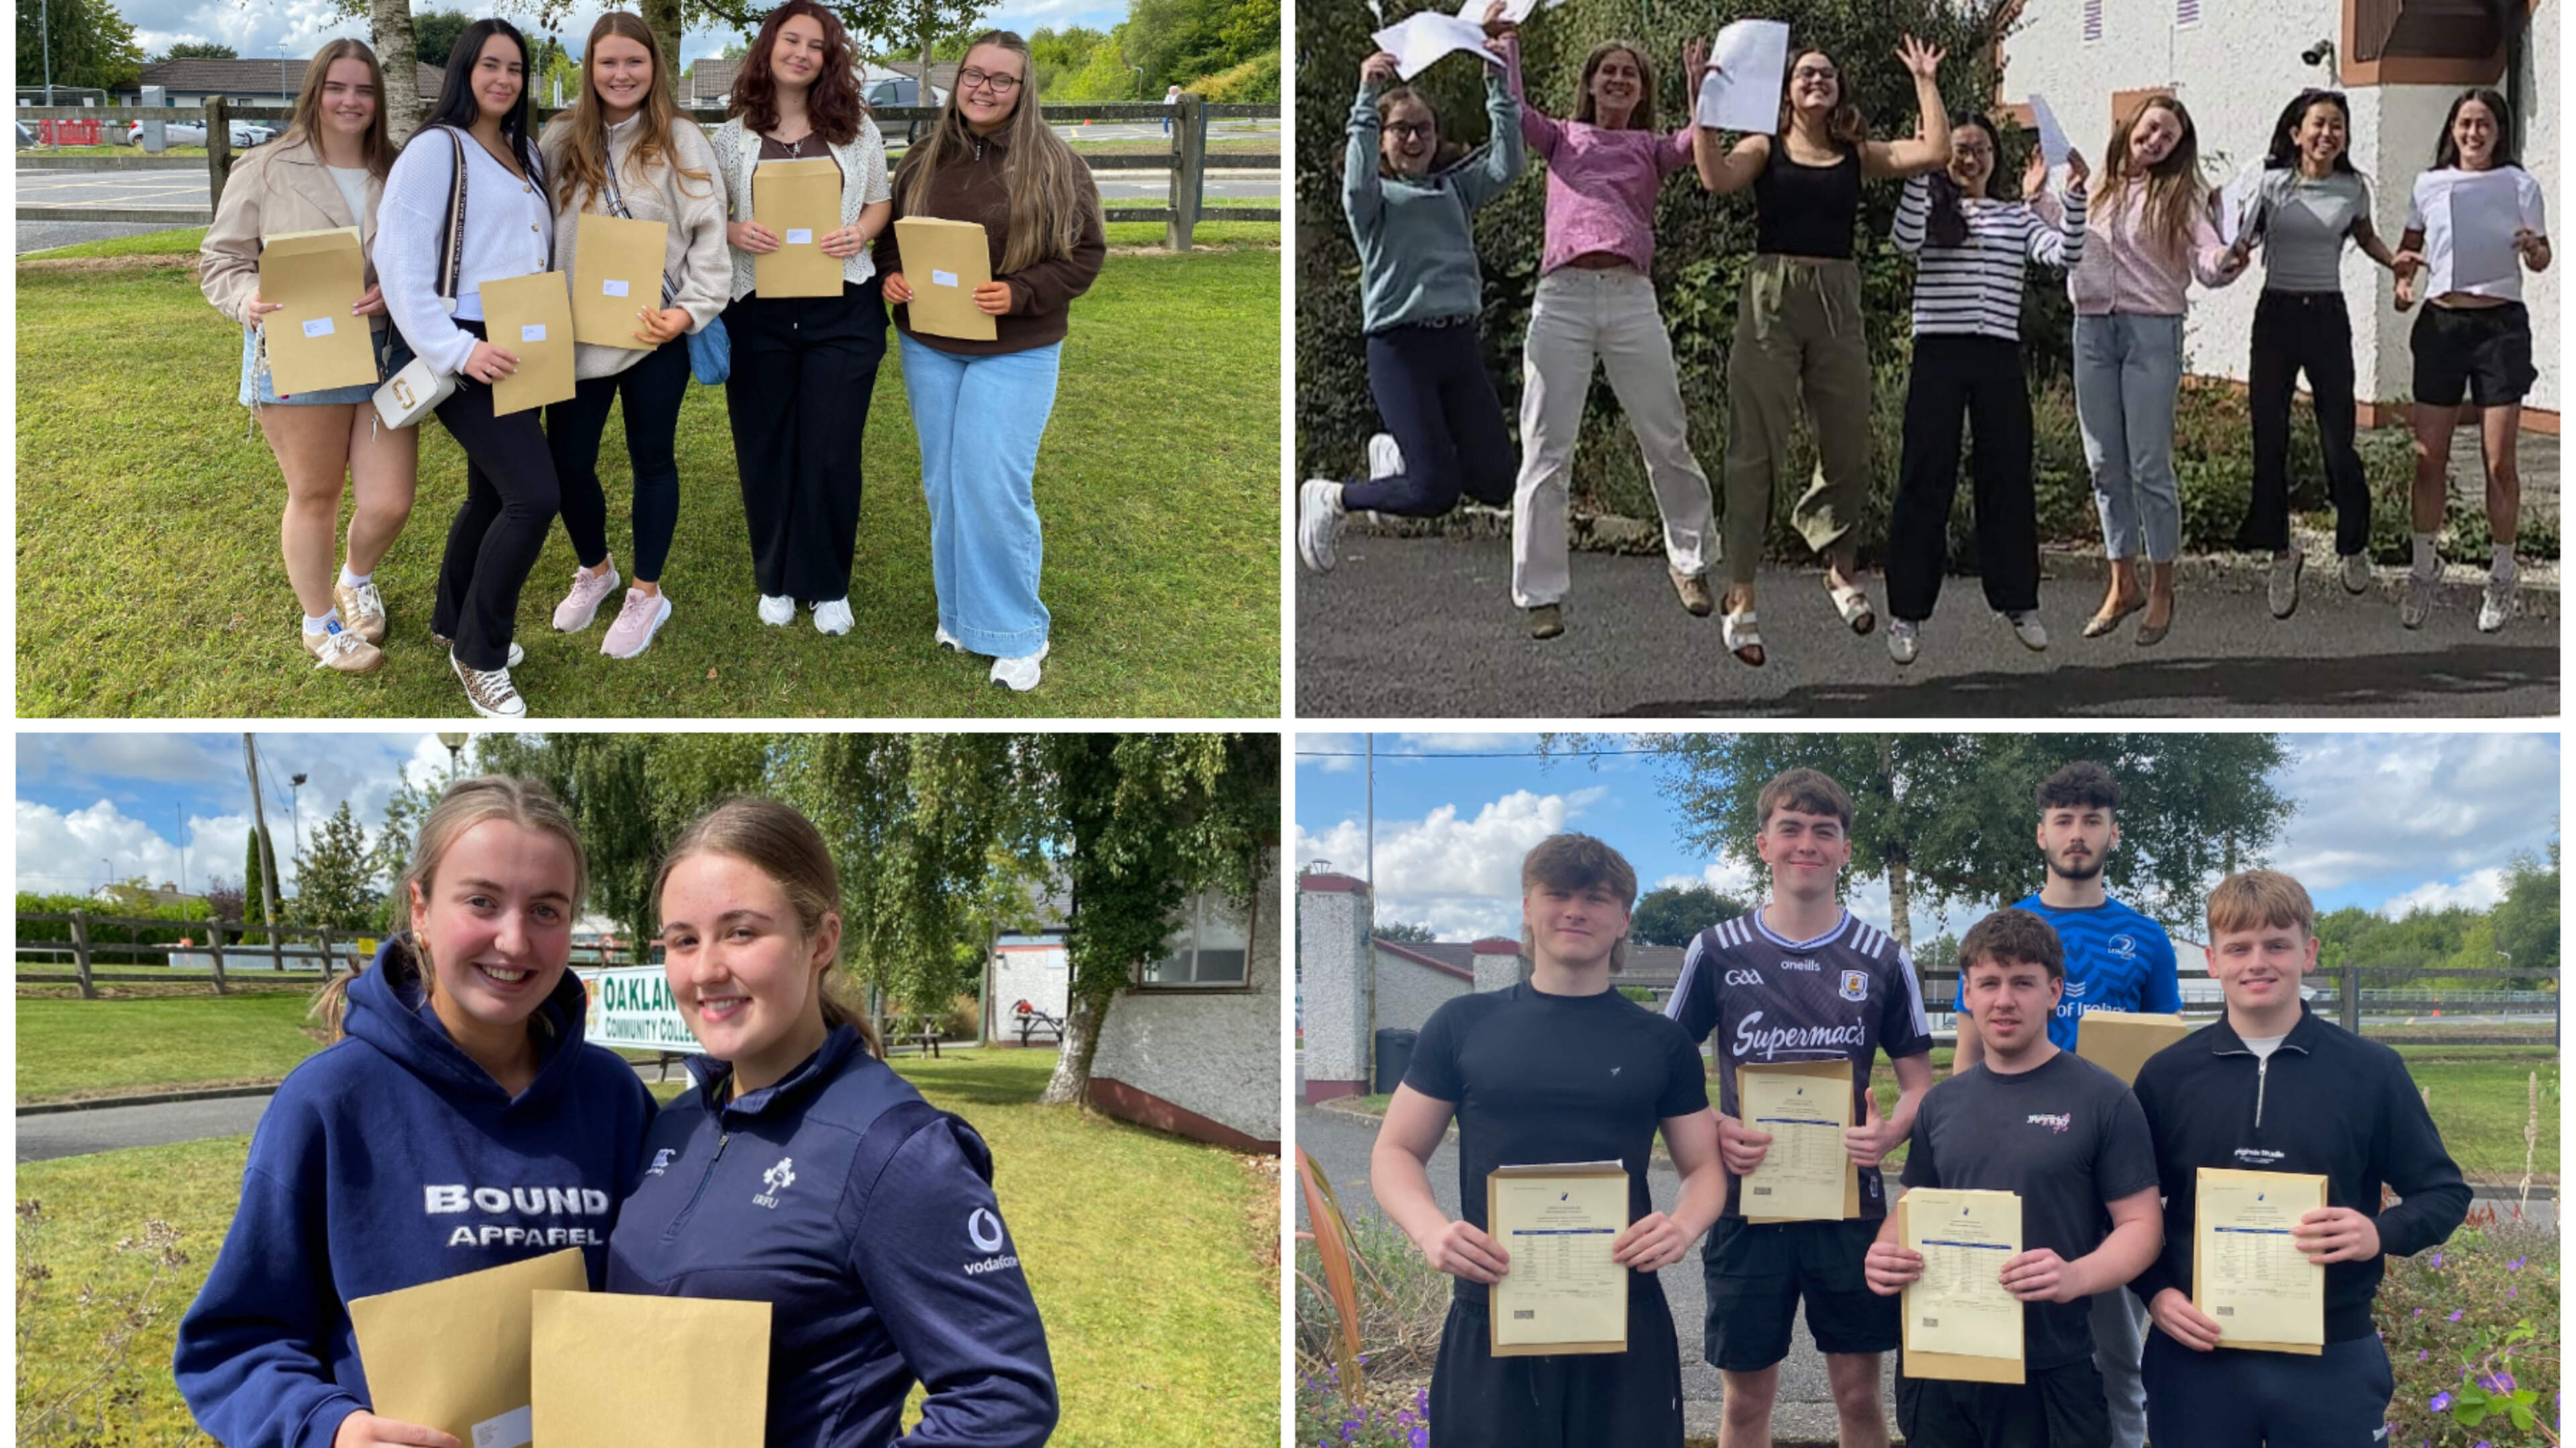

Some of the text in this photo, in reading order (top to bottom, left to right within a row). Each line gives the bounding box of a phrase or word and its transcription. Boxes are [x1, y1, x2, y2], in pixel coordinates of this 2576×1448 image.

[1780, 959, 1821, 971] oneills
[1733, 1011, 1866, 1060] Supermac's
[425, 1184, 608, 1216] BOUND
[447, 1225, 604, 1247] APPAREL
